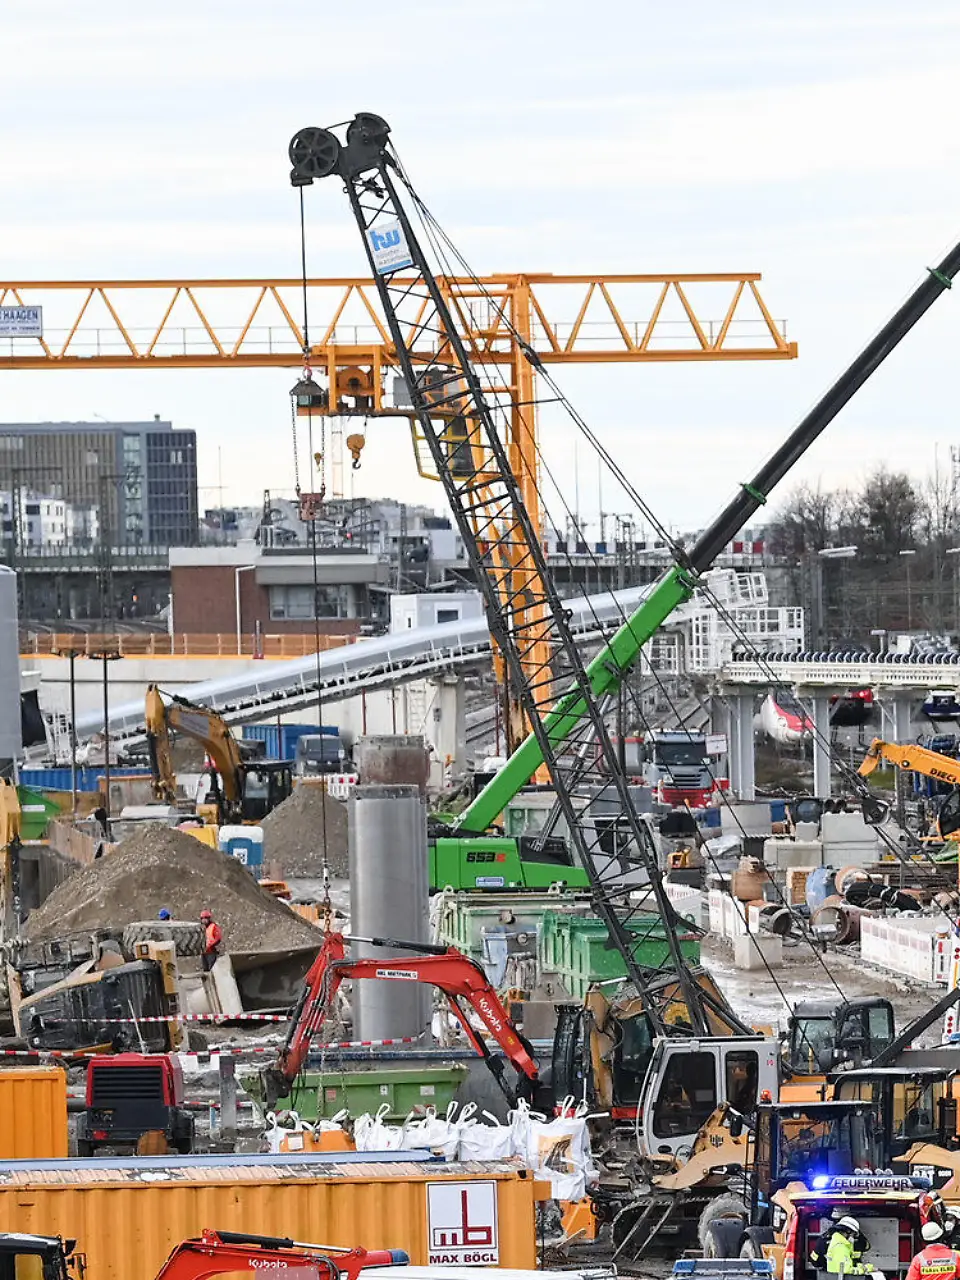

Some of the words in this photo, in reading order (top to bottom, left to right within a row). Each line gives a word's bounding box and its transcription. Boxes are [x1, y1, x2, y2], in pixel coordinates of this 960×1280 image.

[929, 767, 958, 782] DIECI
[479, 997, 503, 1032] Kubota
[833, 1178, 910, 1189] FEUERWEHR
[249, 1259, 289, 1268] Kubota
[429, 1254, 459, 1264] MAX
[464, 1251, 498, 1263] BÖGL
